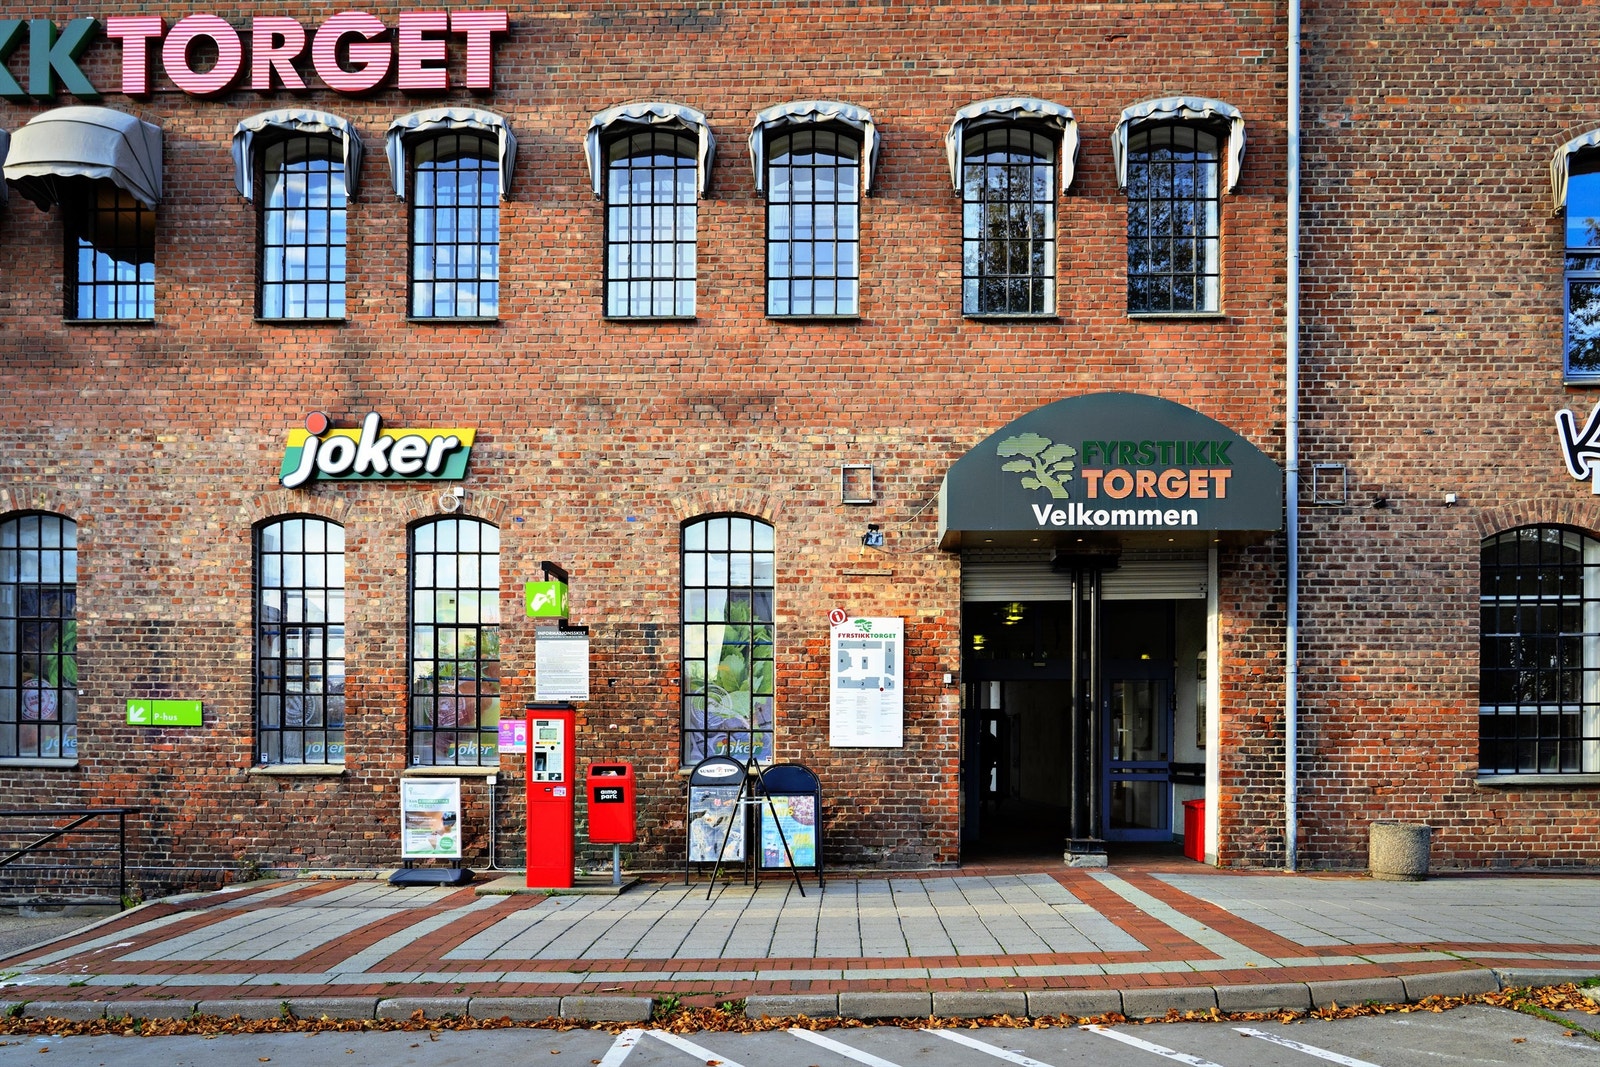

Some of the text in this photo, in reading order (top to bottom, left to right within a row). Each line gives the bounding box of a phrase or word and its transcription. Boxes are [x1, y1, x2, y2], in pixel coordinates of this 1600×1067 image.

[281, 411, 460, 489] joker
[1082, 440, 1233, 466] FYRSTIKK
[1082, 468, 1233, 499] TORGET
[1031, 503, 1198, 526] Velkommen
[154, 712, 178, 721] P-hus
